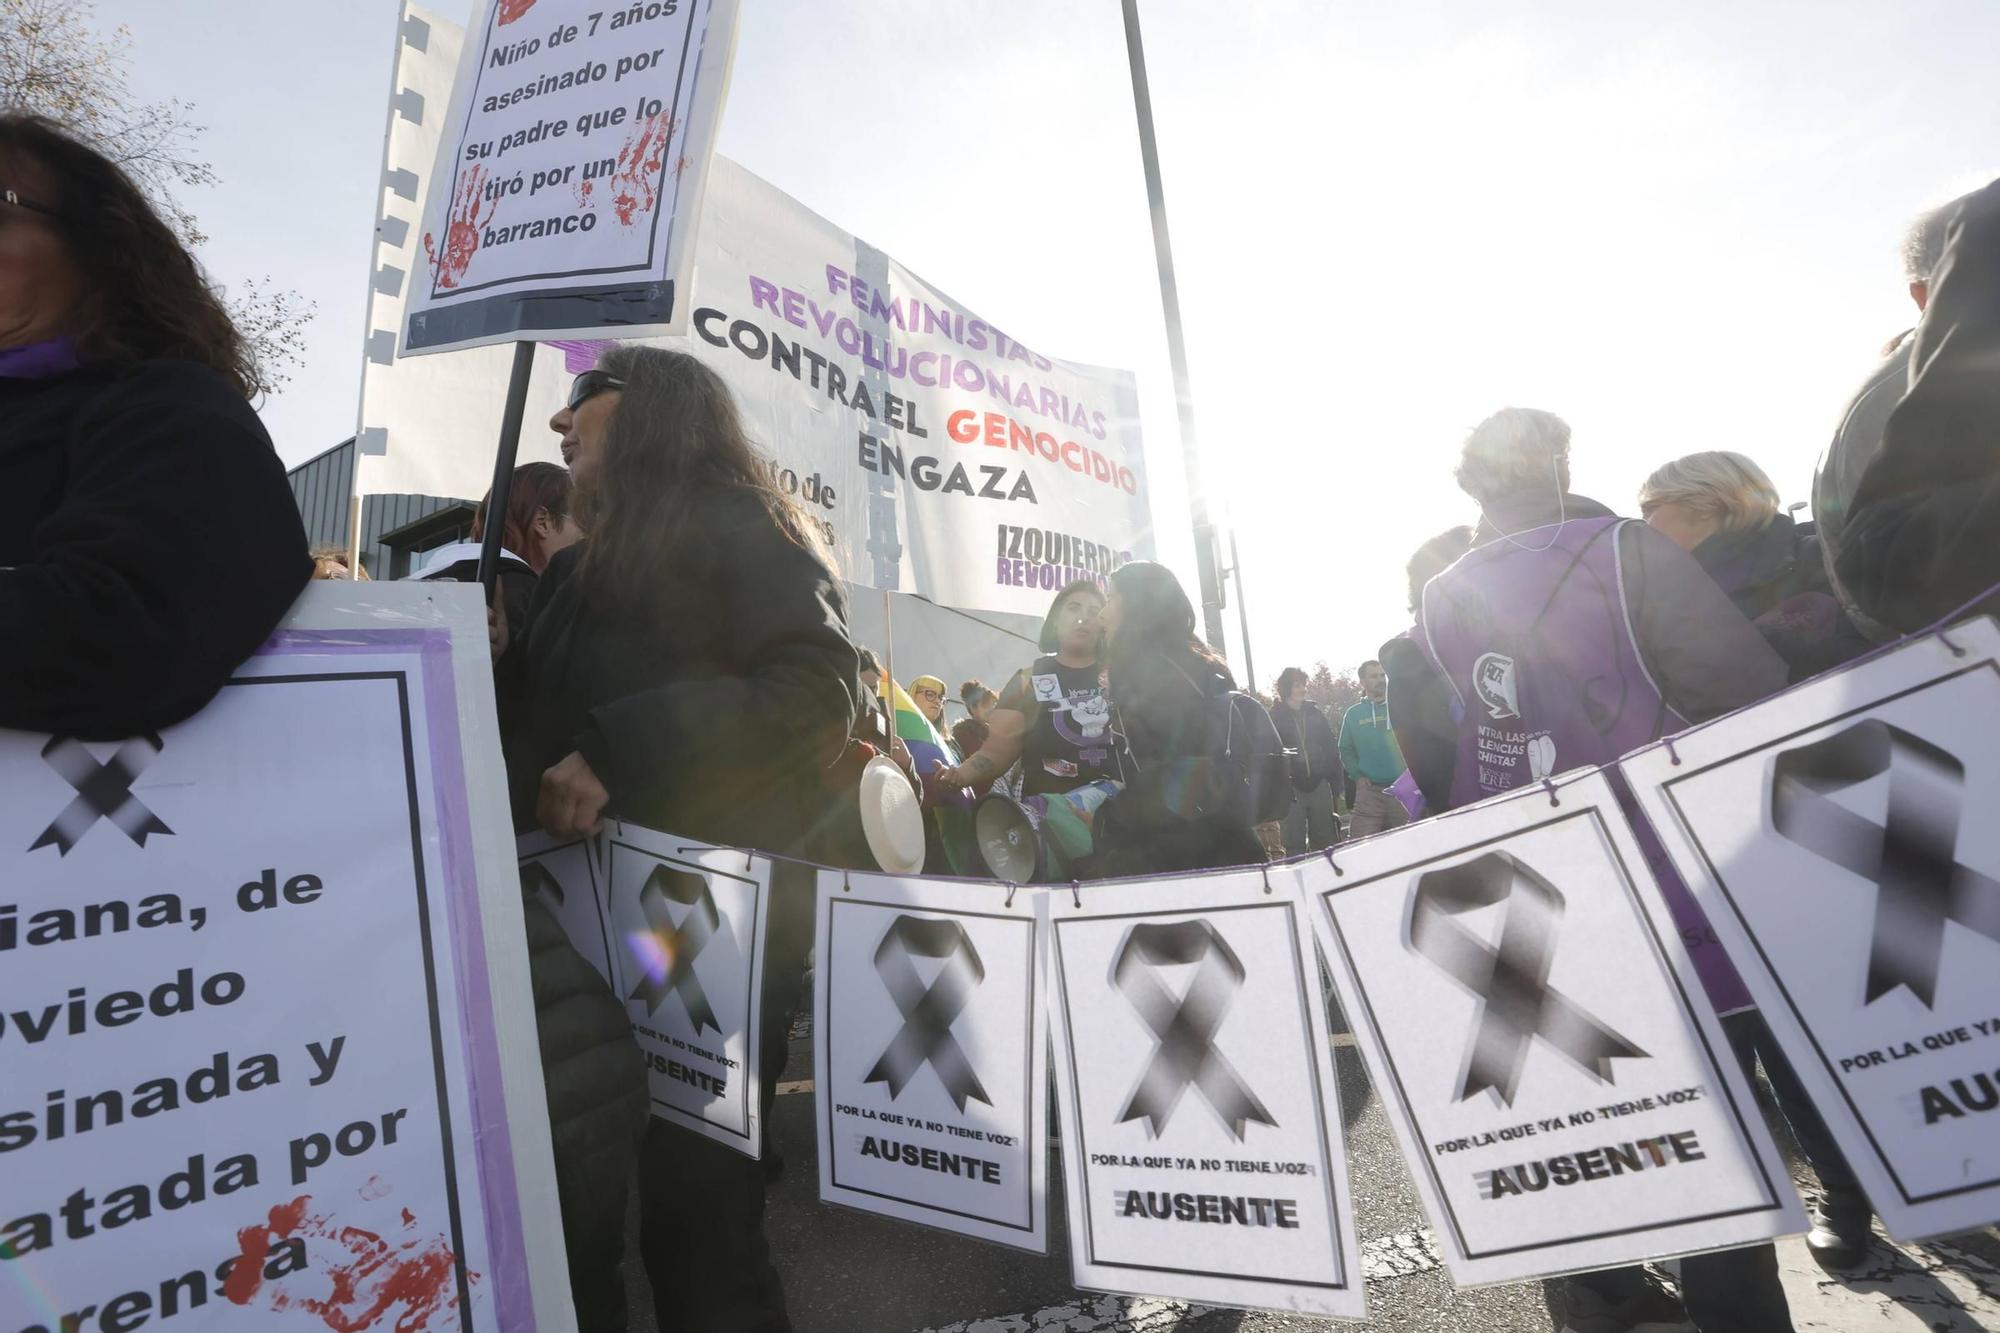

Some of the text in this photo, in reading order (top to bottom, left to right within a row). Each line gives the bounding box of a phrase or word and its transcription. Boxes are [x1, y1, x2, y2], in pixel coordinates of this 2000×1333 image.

[490, 0, 678, 68] Niño de 7 años
[482, 48, 664, 113] asesinado por
[465, 98, 662, 161] su padre que lo
[485, 158, 616, 201] tiró por un
[482, 212, 597, 249] barranco
[749, 275, 1107, 441] REVOLUCIONARIAS
[693, 308, 1137, 496] CONTRA EL GENOCIDIO
[802, 473, 836, 509] de
[1478, 737, 1525, 755] LENCIAS
[1506, 731, 1526, 743] LAS
[236, 868, 323, 912] de
[0, 968, 245, 1044] viedo
[659, 1033, 671, 1044] YA
[672, 1039, 685, 1049] NO
[687, 1044, 714, 1061] TIENE
[1839, 1050, 1887, 1073] POR
[1888, 1042, 1921, 1059] LA
[1922, 1027, 1972, 1050] QUE
[0, 1035, 346, 1153] sinada y
[1920, 1068, 2000, 1125] AU
[836, 1104, 1013, 1147] POR LA QUE YA NO TIENE VOZ
[1435, 1088, 1700, 1155] POR LA QUE YA NO TIENE VOZ
[0, 1108, 407, 1260] atada por
[860, 1136, 1001, 1185] AUSENTE
[1091, 1154, 1308, 1175] POR LA QUE YA NO TIENE VOZ
[1490, 1130, 1706, 1200] AUSENTE
[1123, 1190, 1300, 1229] AUSENTE
